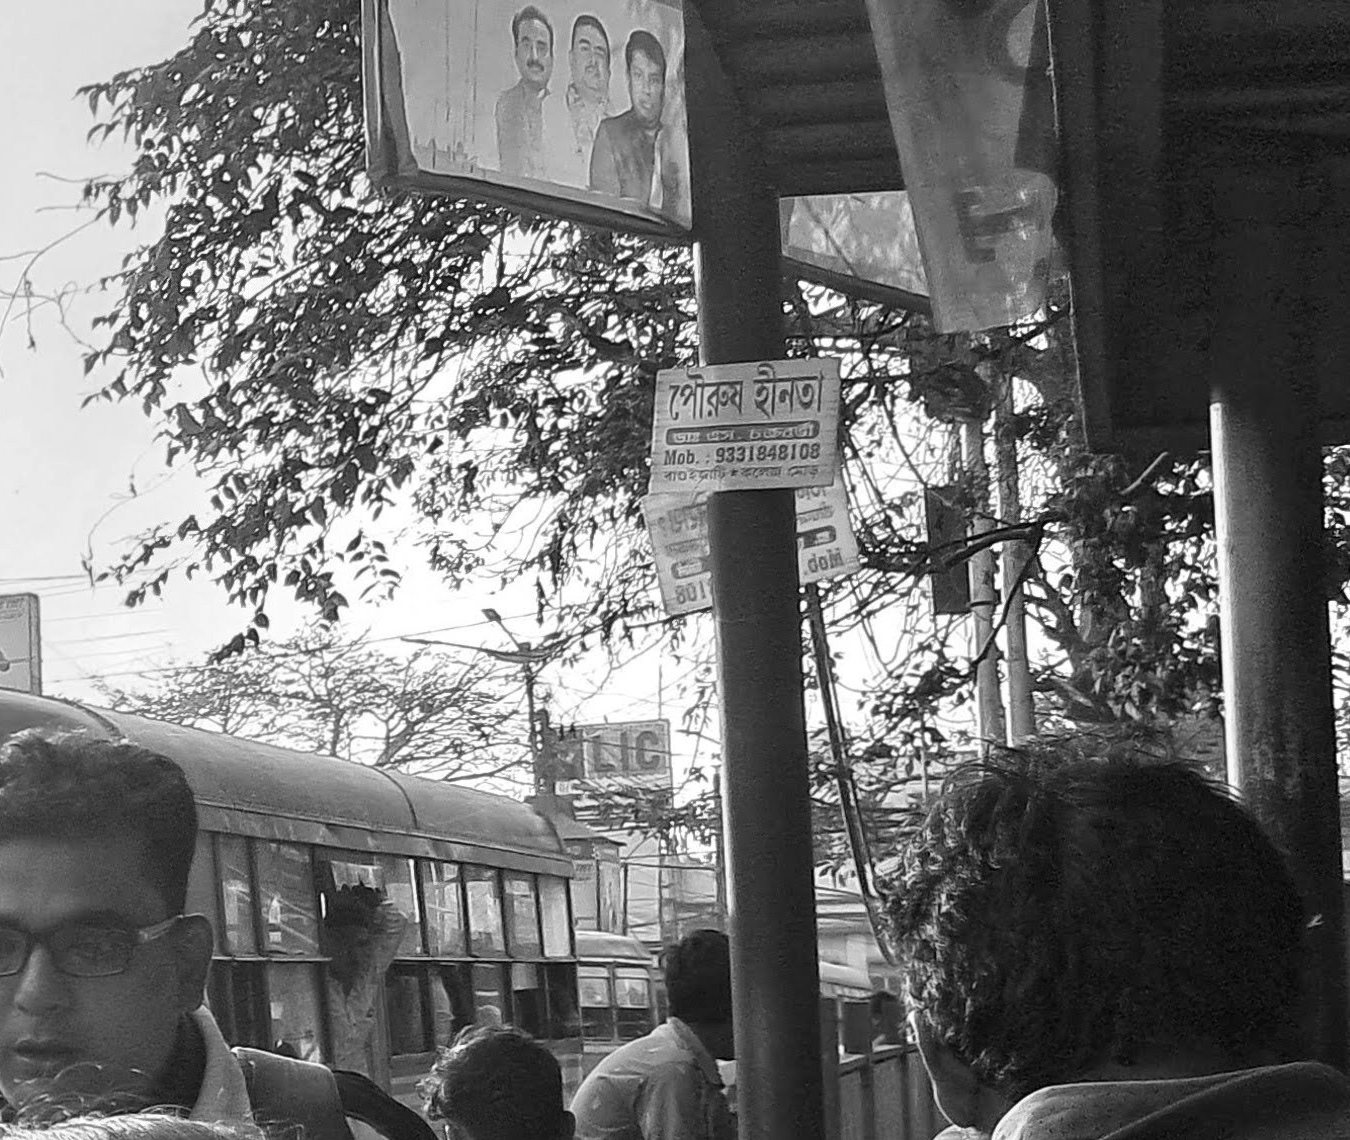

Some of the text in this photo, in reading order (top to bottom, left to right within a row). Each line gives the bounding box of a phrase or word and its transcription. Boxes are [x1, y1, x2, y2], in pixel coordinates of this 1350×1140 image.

[669, 363, 824, 421] পৌরুষ হীনতা
[664, 450, 699, 466] Mob.
[715, 443, 821, 463] 9331848108
[595, 730, 661, 772] LIC
